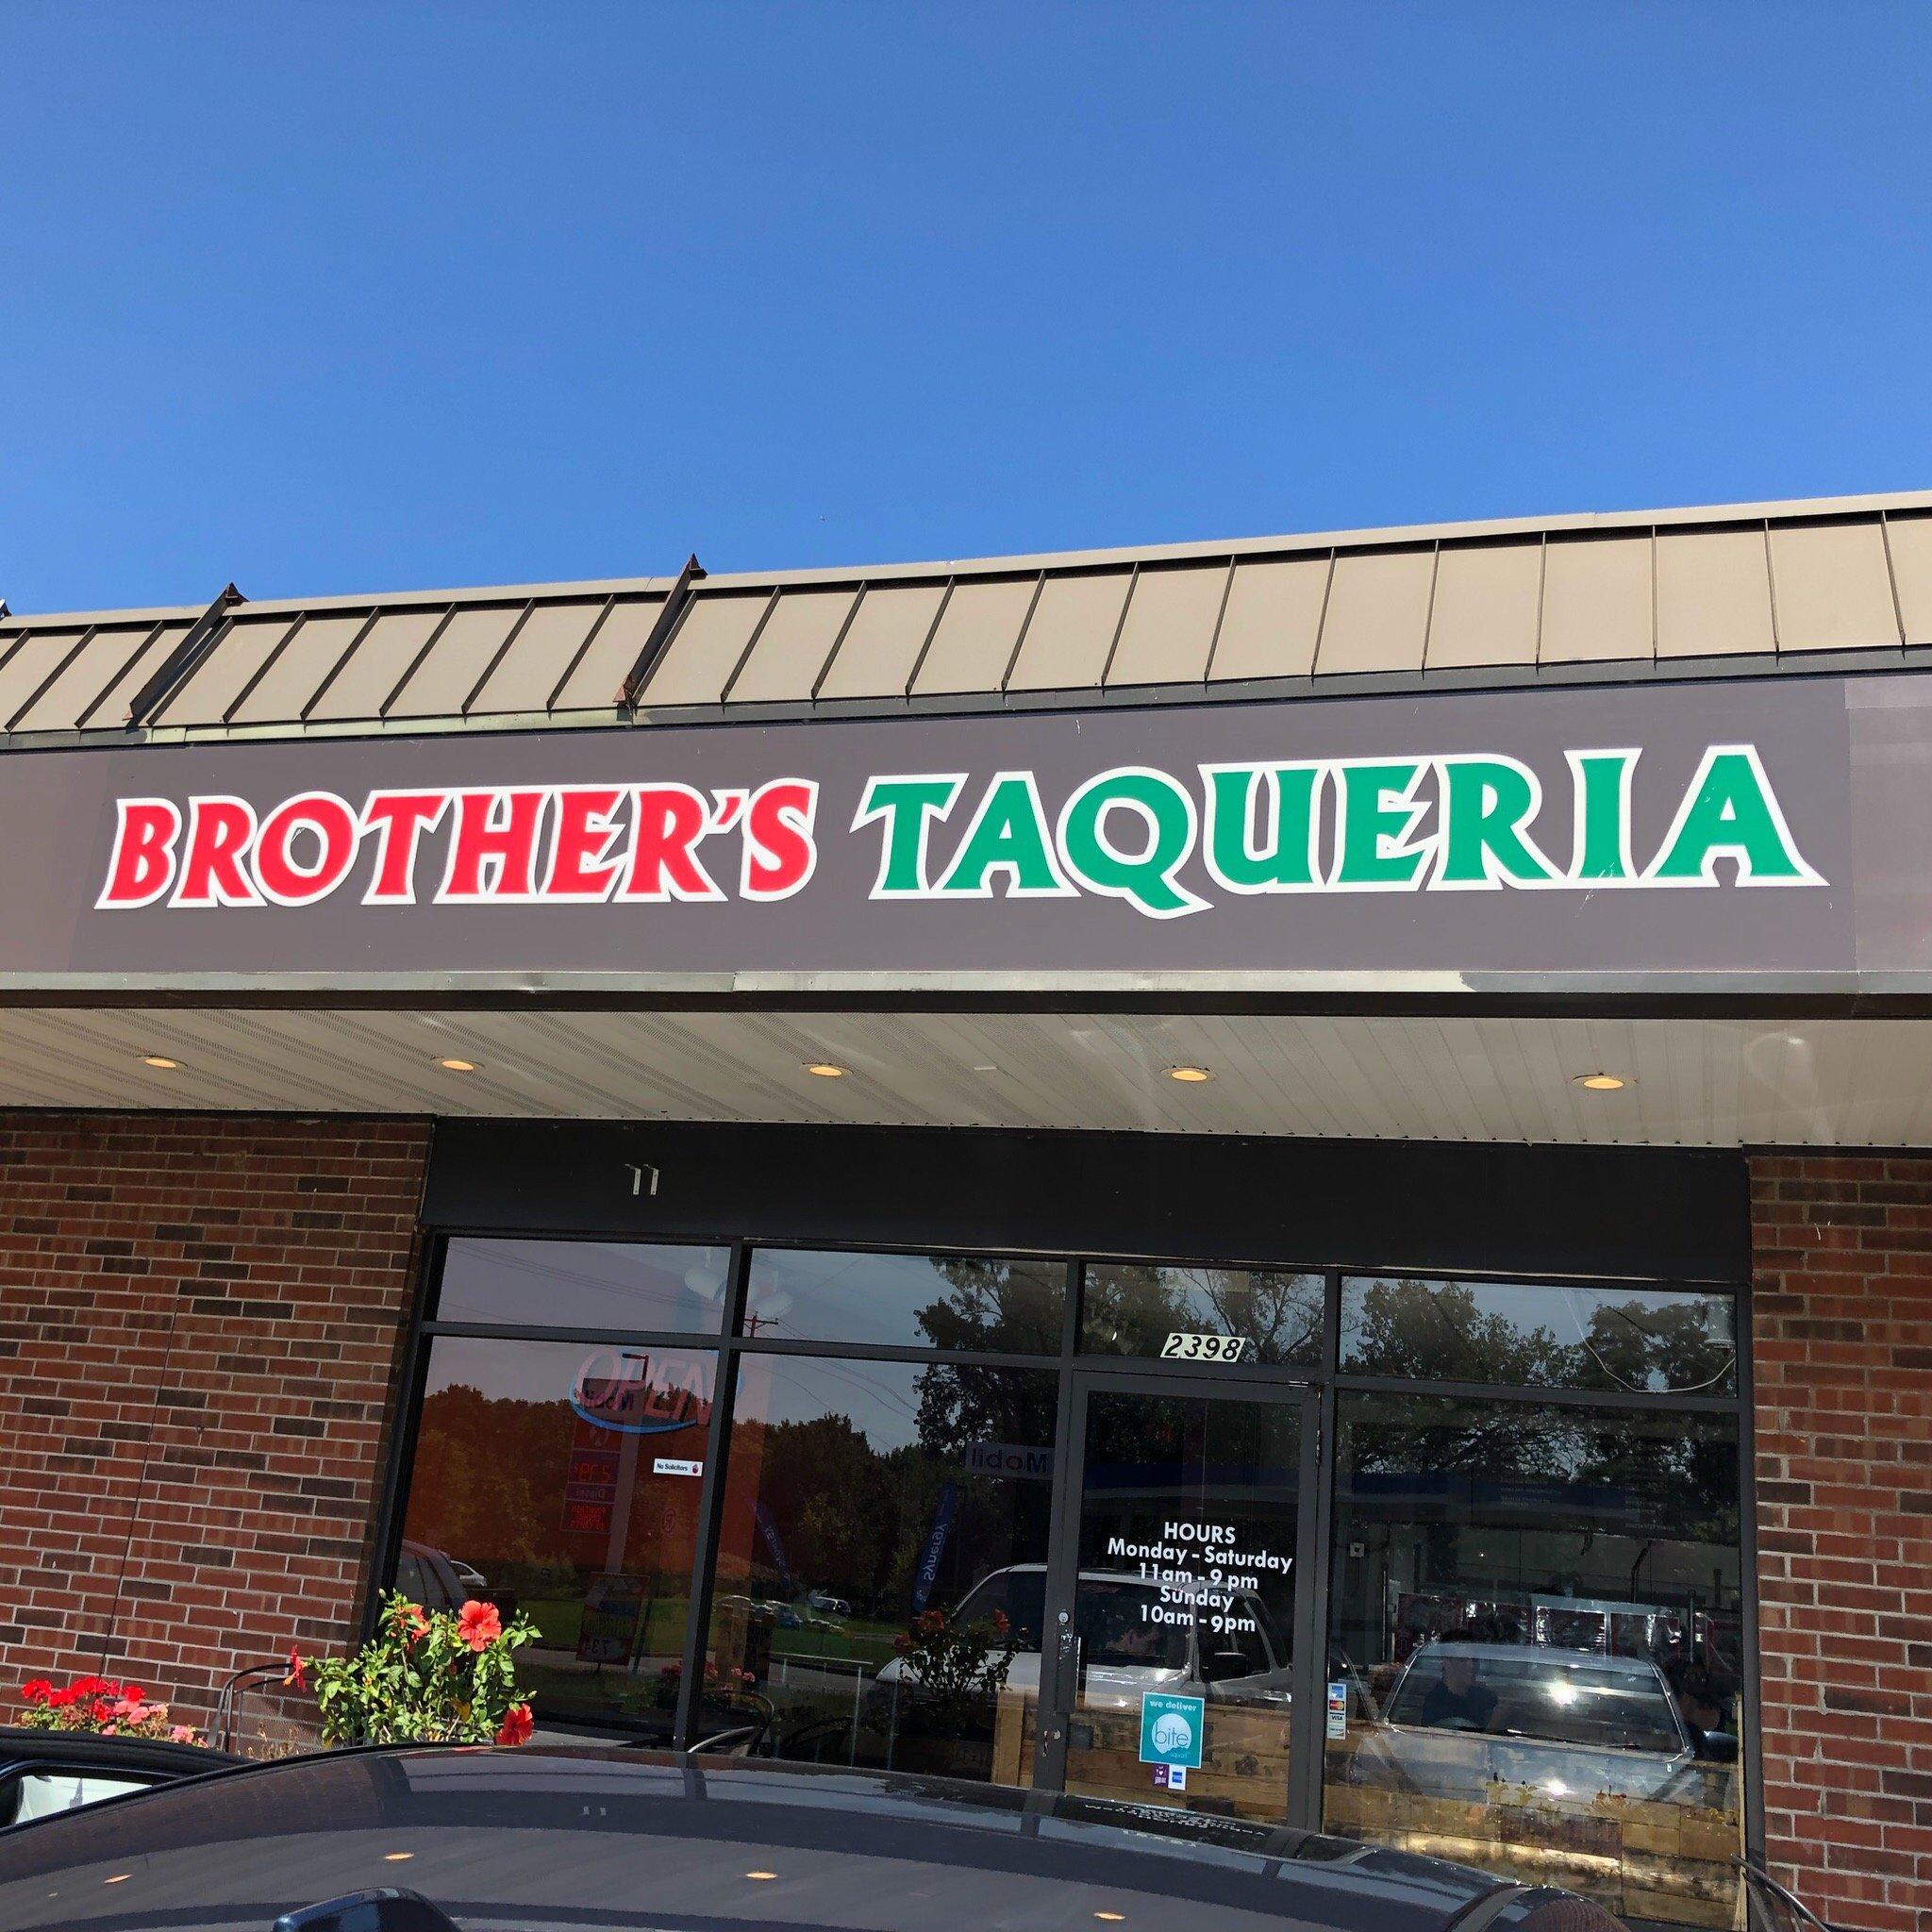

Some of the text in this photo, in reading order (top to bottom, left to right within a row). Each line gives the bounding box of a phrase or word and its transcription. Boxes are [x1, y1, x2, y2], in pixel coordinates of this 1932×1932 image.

[849, 743, 1830, 920] TAQUERIA
[1164, 1335, 1241, 1360] 2398
[576, 1348, 714, 1425] OPEN
[1164, 1522, 1236, 1544] HOURS
[1108, 1538, 1188, 1565] Monday
[1205, 1546, 1293, 1574] Saturday
[1140, 1562, 1192, 1583] 11am
[1227, 1574, 1258, 1591] pm
[1159, 1585, 1235, 1613] Sunday
[1141, 1605, 1193, 1626] 10am
[1210, 1616, 1256, 1634] 9pm
[1150, 1700, 1196, 1711] we deliver
[1155, 1722, 1188, 1747] bite
